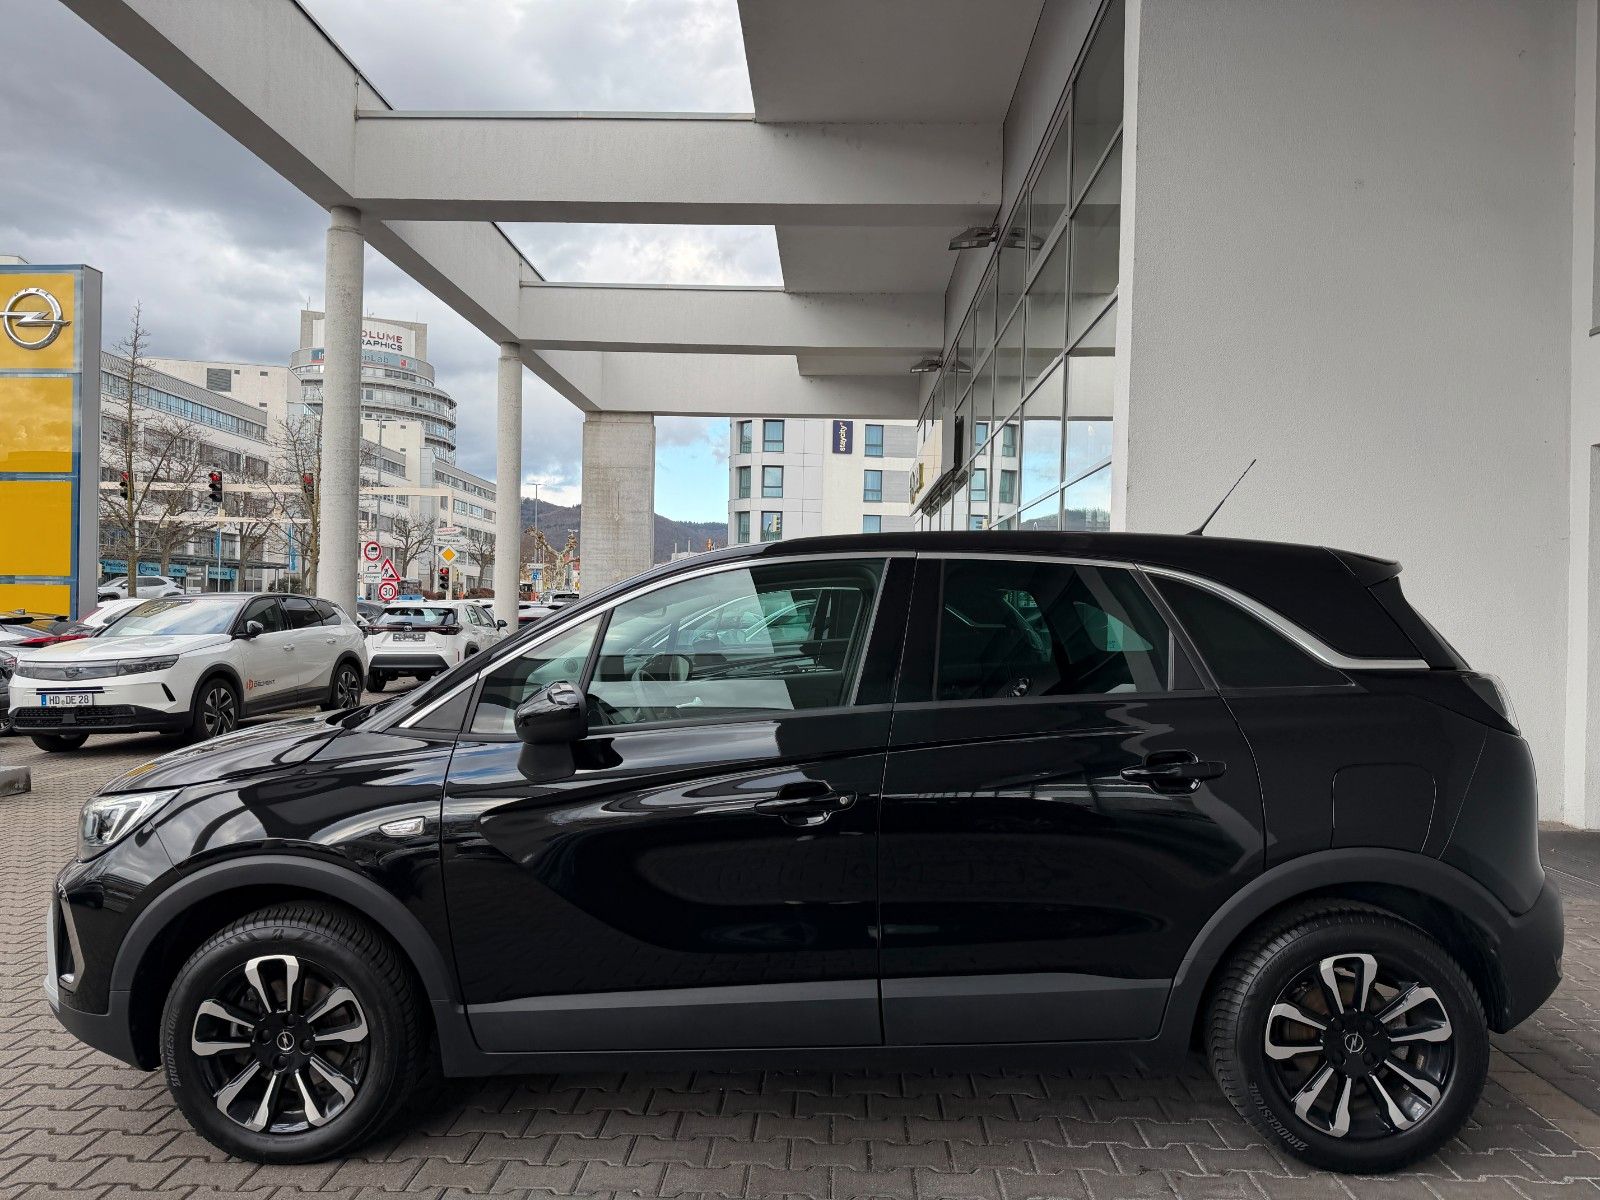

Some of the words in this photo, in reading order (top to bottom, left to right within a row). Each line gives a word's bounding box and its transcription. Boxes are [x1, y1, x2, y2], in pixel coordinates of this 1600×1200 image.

[361, 330, 403, 344] OLUME
[361, 339, 403, 352] RAPHICS
[382, 587, 394, 597] 30
[49, 695, 60, 705] HD
[65, 695, 77, 705] DE
[78, 694, 90, 705] 28
[166, 1006, 181, 1087] BRIDGESTONE
[1248, 1080, 1310, 1151] BRIDGESTONE
